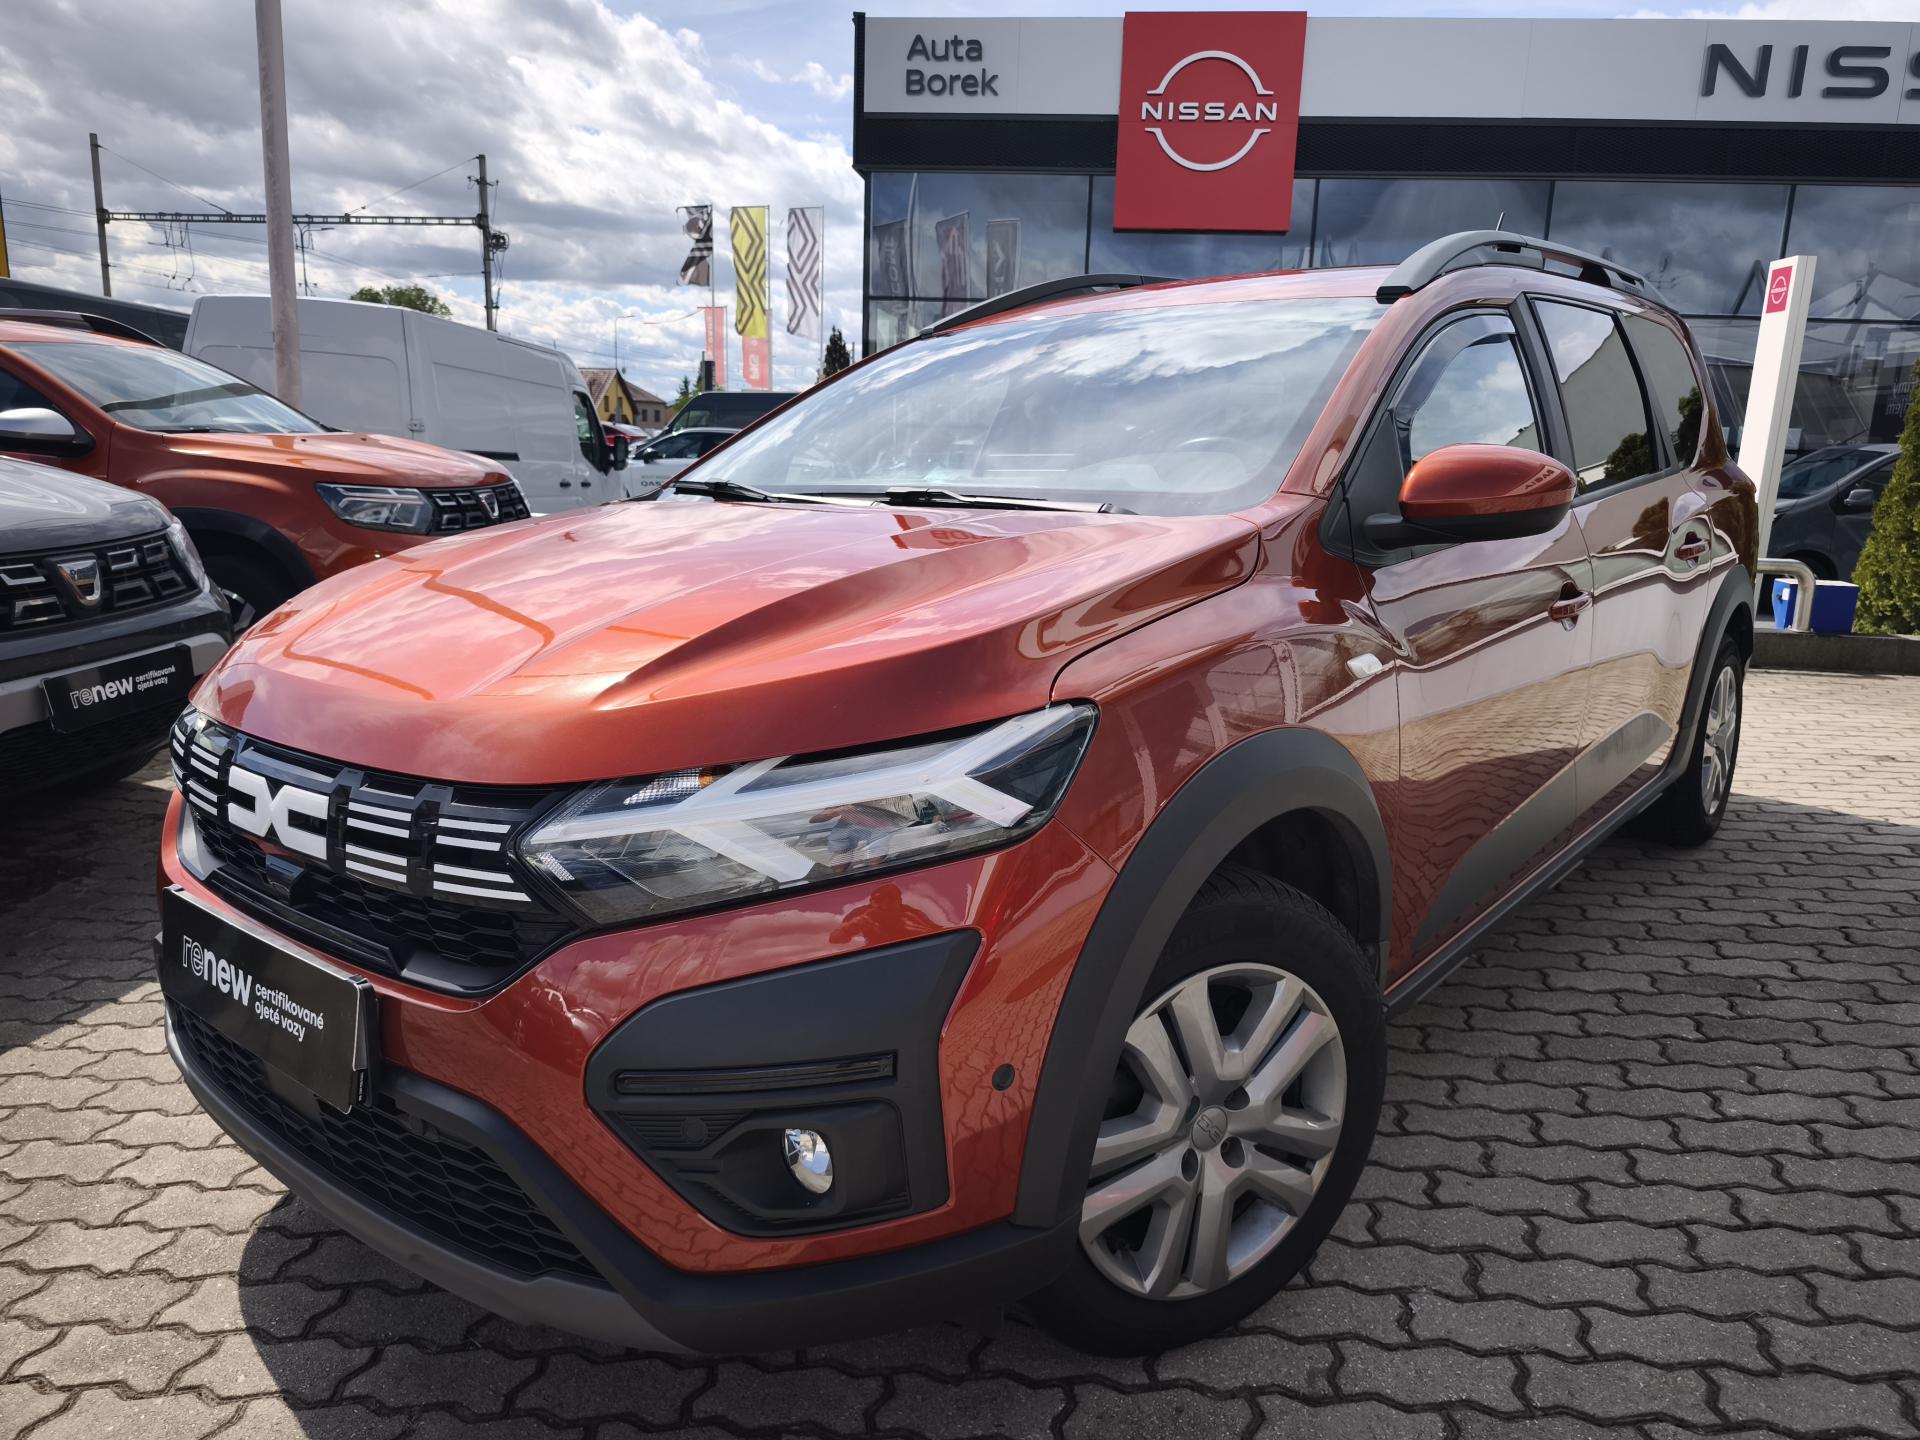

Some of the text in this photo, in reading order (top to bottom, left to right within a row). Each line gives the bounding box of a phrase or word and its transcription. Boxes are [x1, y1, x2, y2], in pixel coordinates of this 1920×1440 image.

[906, 34, 983, 62] Auta
[905, 67, 999, 96] Borek
[1701, 43, 1920, 99] NIS
[1141, 101, 1278, 122] NISSAN
[70, 676, 133, 709] renew
[182, 935, 252, 1006] renew
[255, 983, 324, 1030] certifikované
[255, 1000, 305, 1042] ojeté vozy
